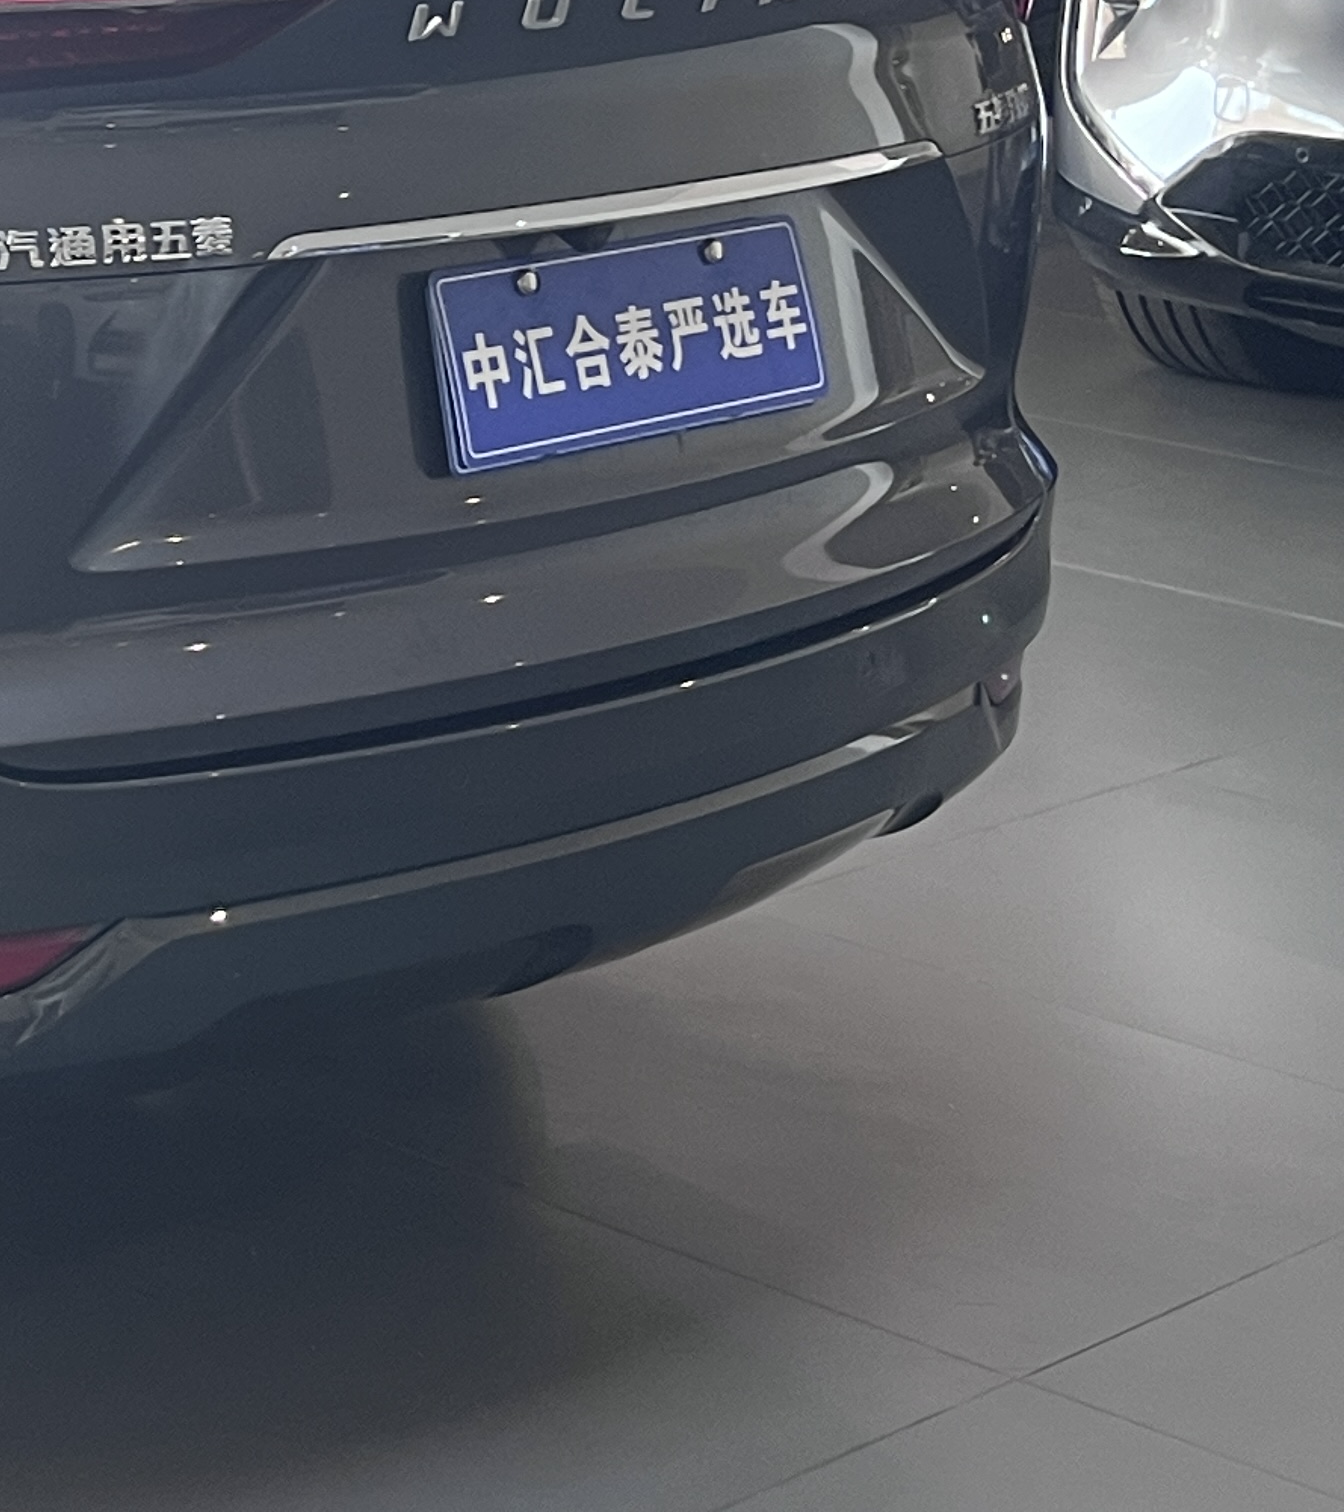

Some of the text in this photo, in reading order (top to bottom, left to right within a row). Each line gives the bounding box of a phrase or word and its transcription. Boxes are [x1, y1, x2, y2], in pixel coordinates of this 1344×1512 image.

[462, 280, 807, 410] 中汇合泰严选车
